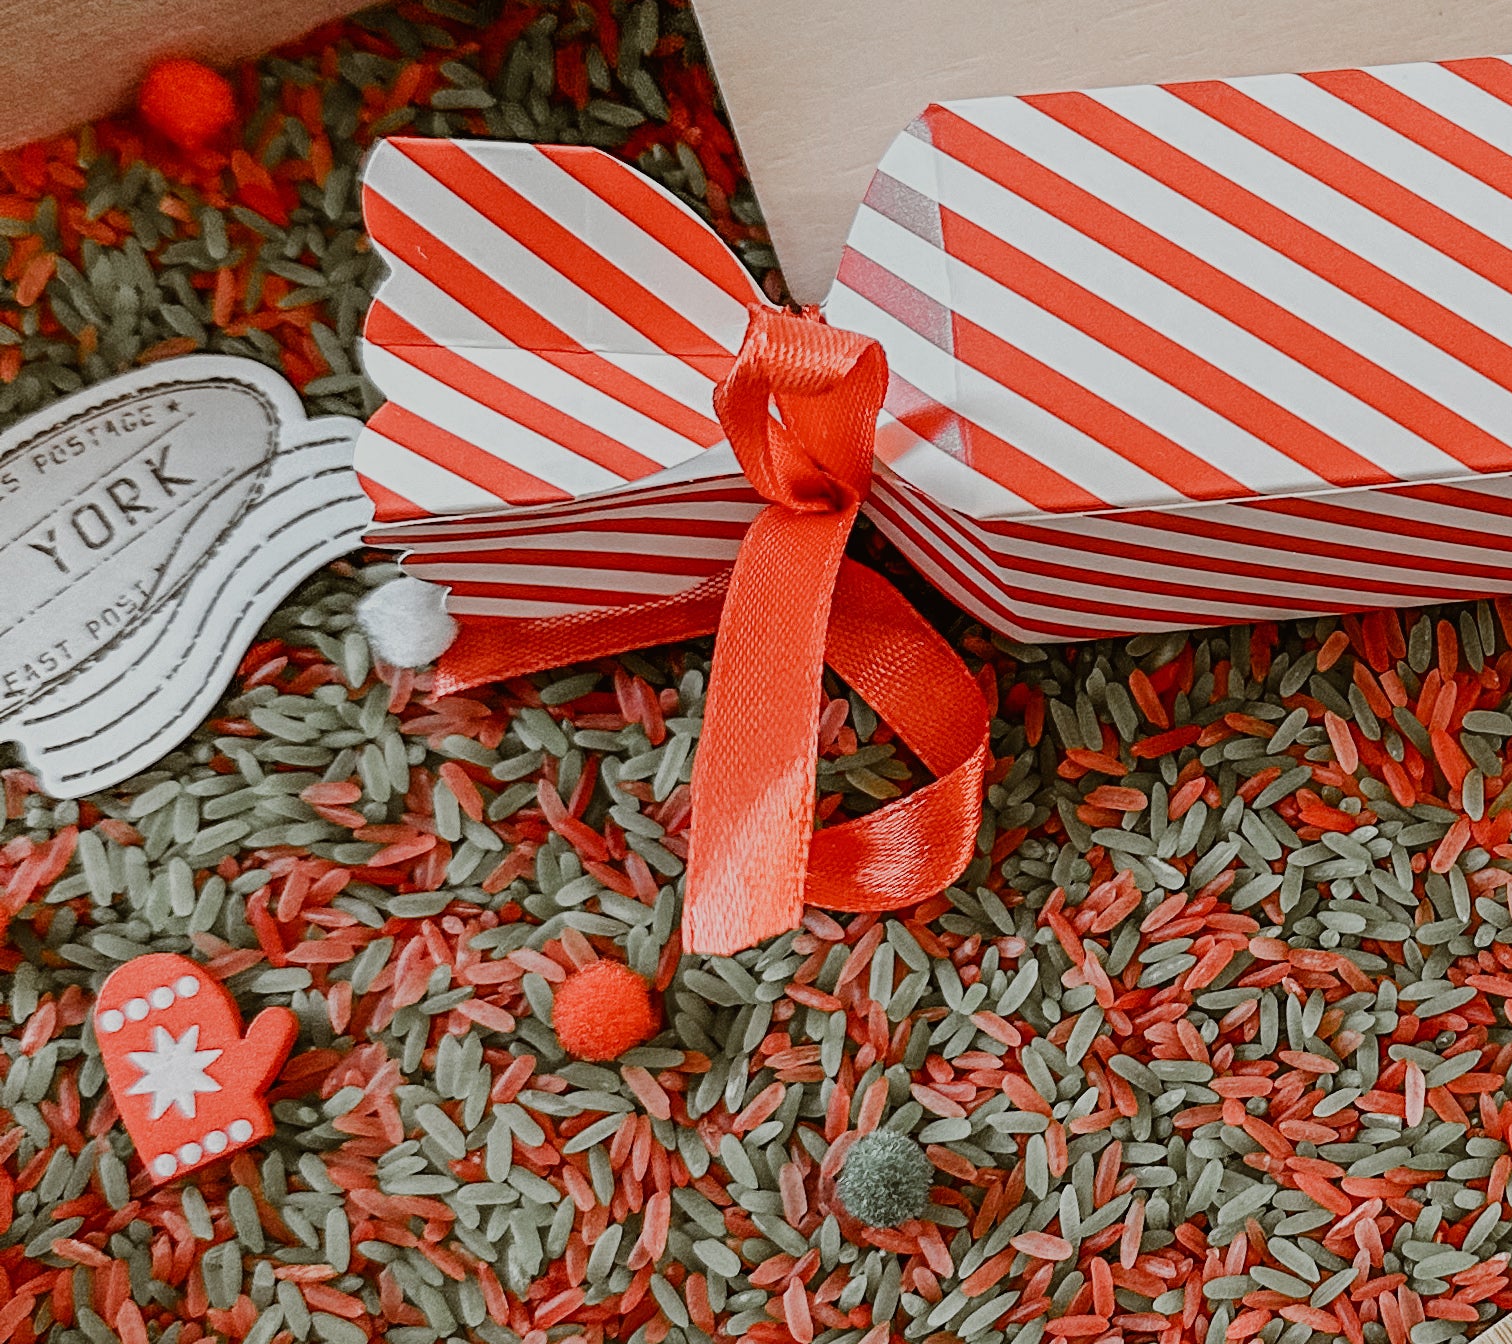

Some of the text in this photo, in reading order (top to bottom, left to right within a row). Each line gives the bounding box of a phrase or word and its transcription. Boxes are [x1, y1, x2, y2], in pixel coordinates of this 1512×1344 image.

[0, 405, 156, 501] S POSTAGE
[28, 444, 196, 574] YORK
[85, 579, 150, 640] POST
